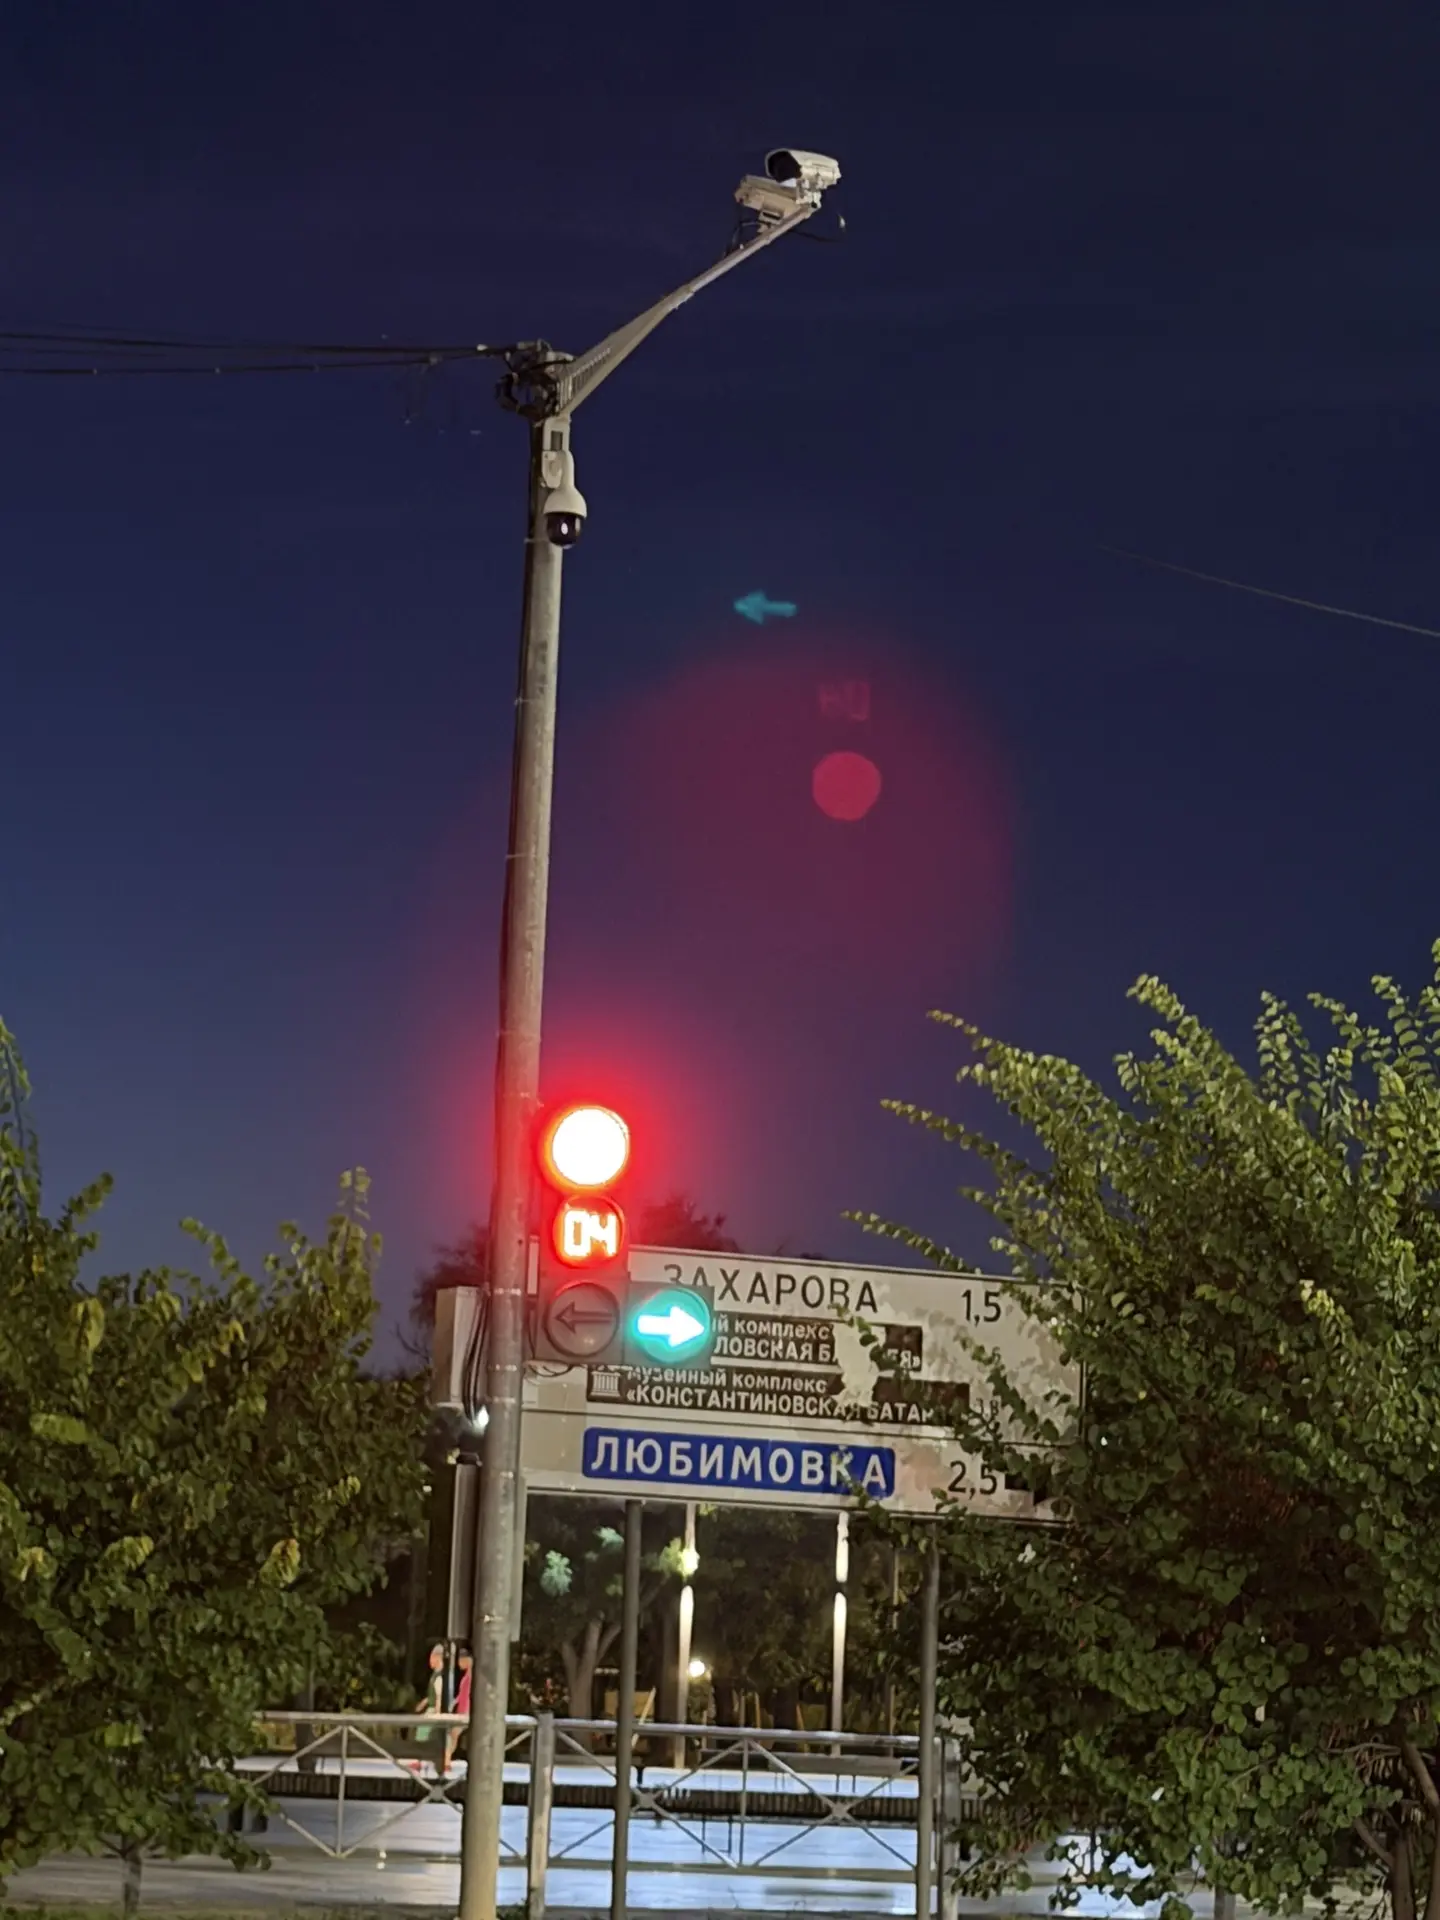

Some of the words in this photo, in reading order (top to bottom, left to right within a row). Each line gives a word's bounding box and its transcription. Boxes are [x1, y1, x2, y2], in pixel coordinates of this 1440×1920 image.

[562, 1209, 617, 1257] 04
[961, 1288, 1001, 1328] 1,5
[734, 1318, 830, 1340] комплекс
[713, 1335, 813, 1361] ЛОВСКАЯ
[732, 1373, 828, 1394] комплекс
[590, 1435, 888, 1490] ЛЮБИМОВКА
[948, 1460, 998, 1500] 2,5
